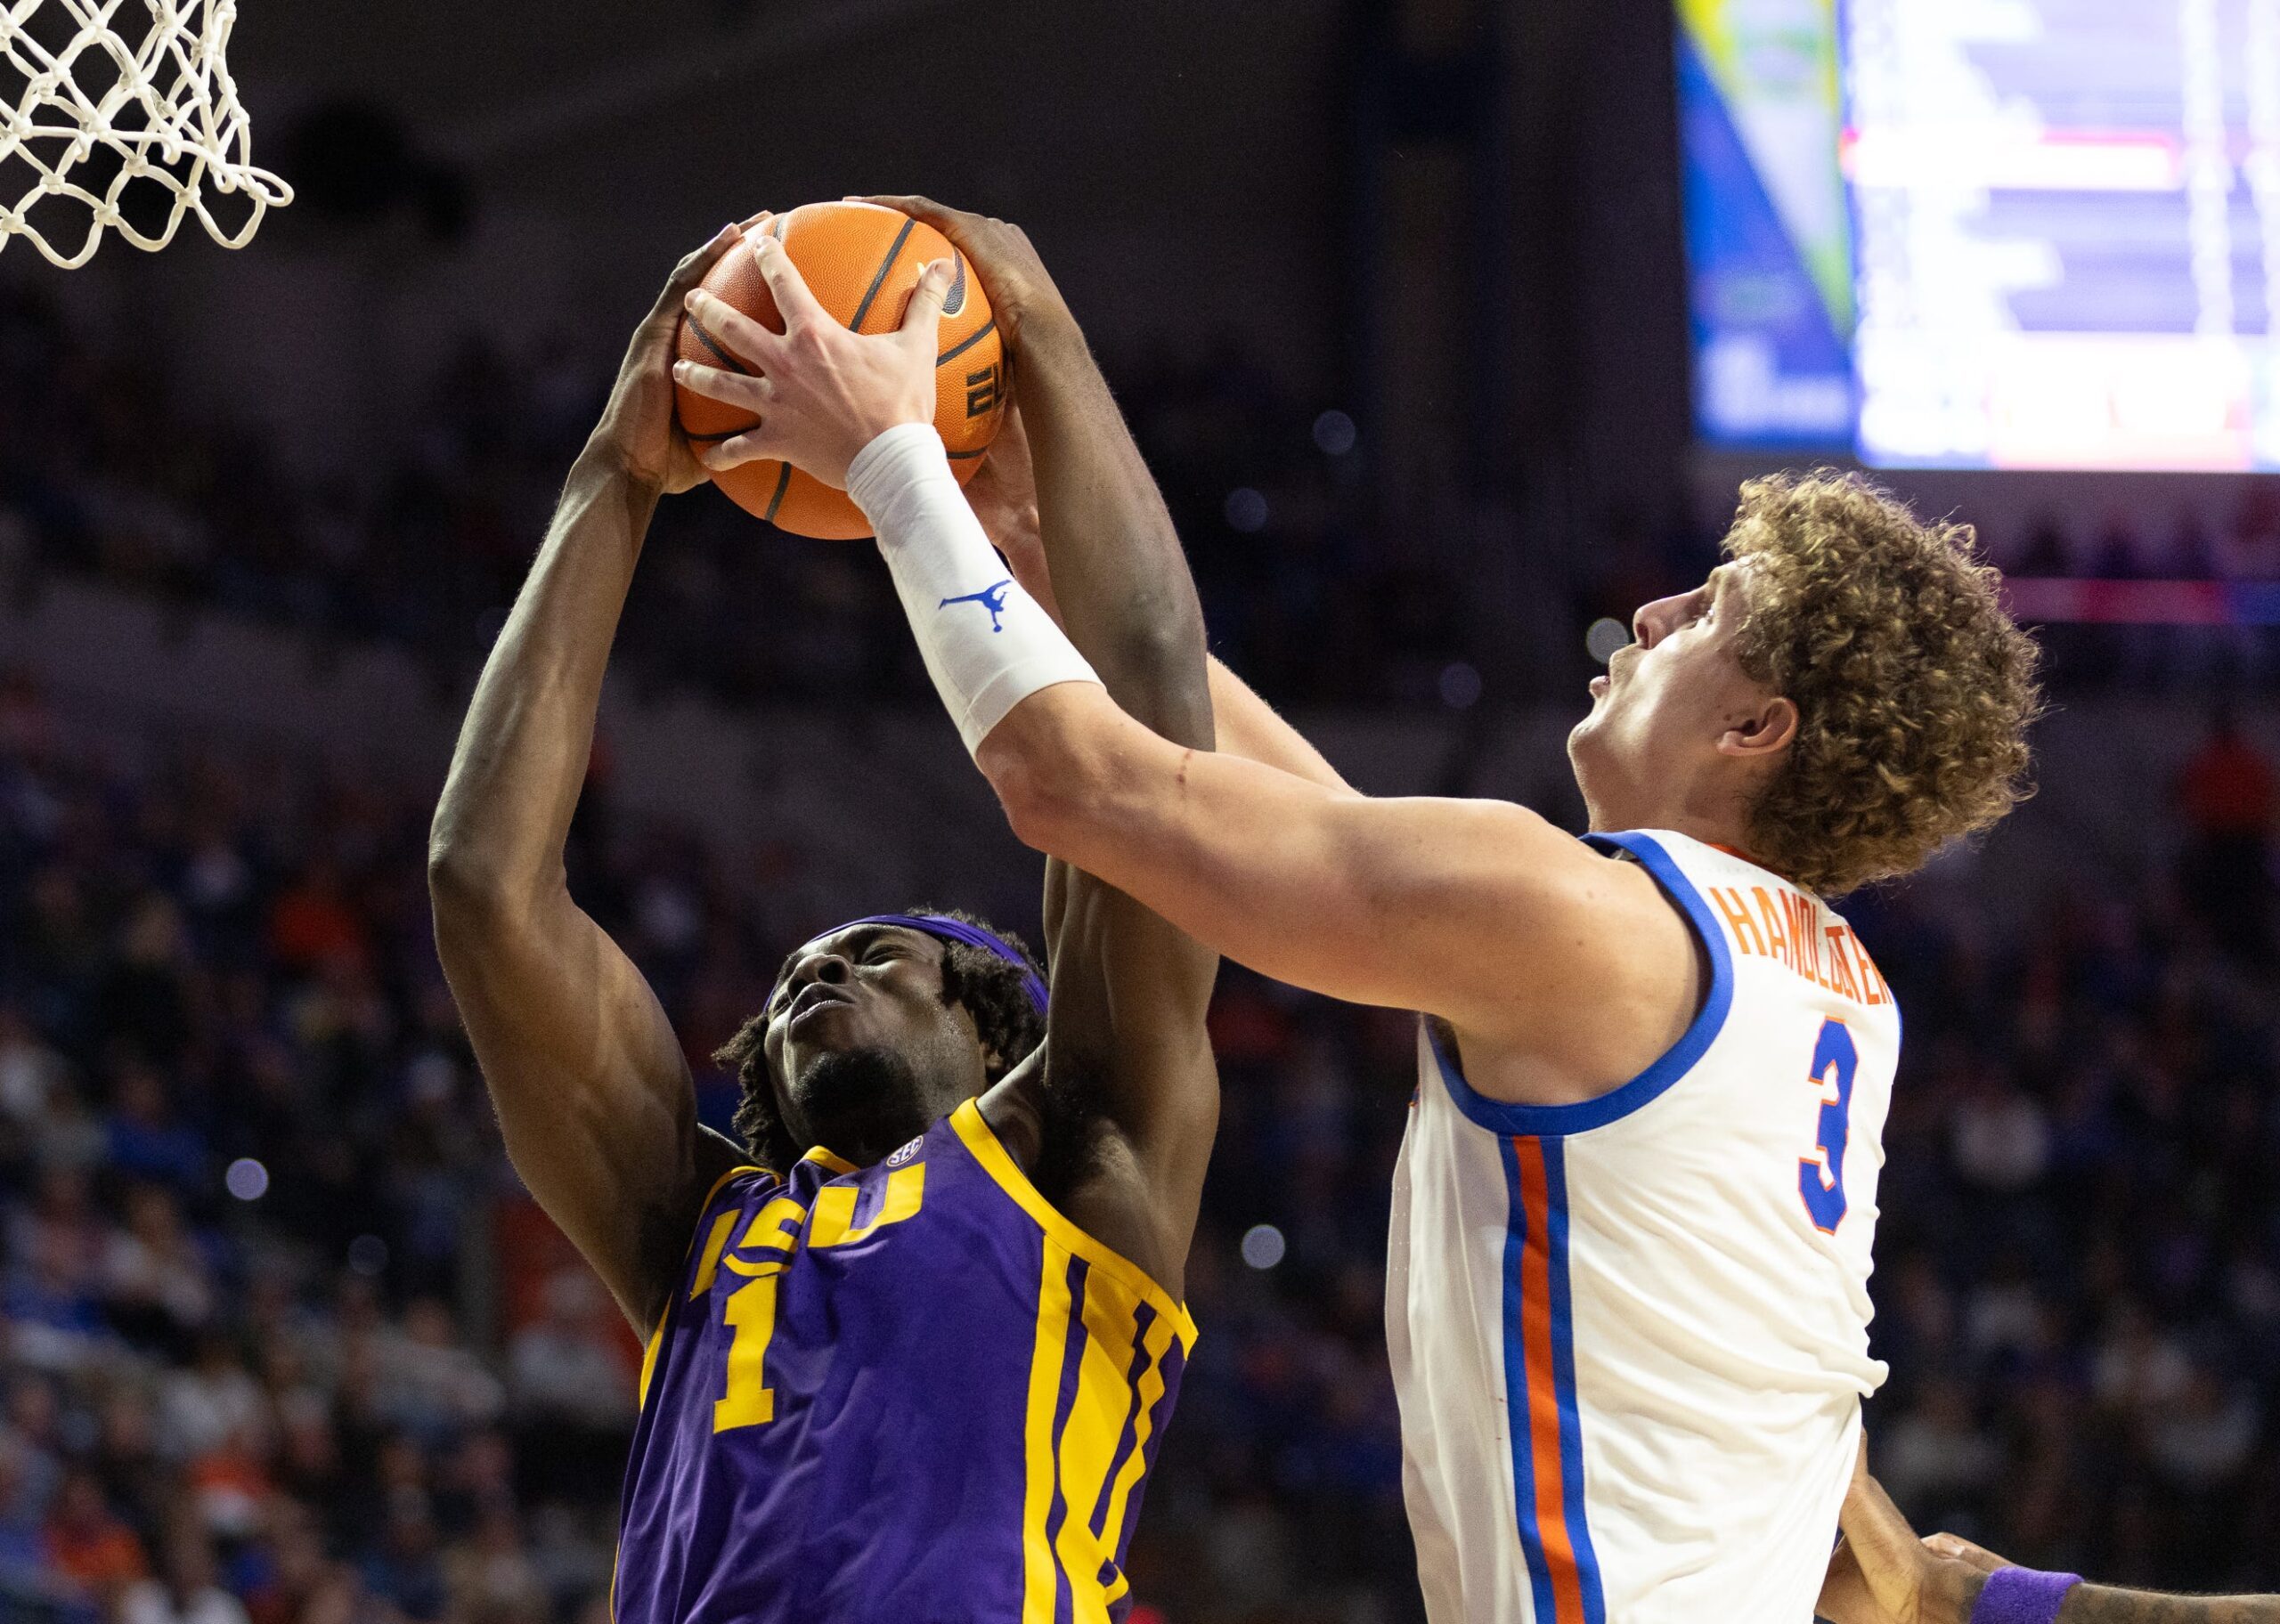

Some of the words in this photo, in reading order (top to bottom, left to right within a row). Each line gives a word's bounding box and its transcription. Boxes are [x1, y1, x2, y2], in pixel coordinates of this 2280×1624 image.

[891, 1138, 920, 1164] SEC
[1797, 1014, 1860, 1237] 3
[688, 1161, 926, 1303] LSU
[712, 1274, 778, 1434] 1
